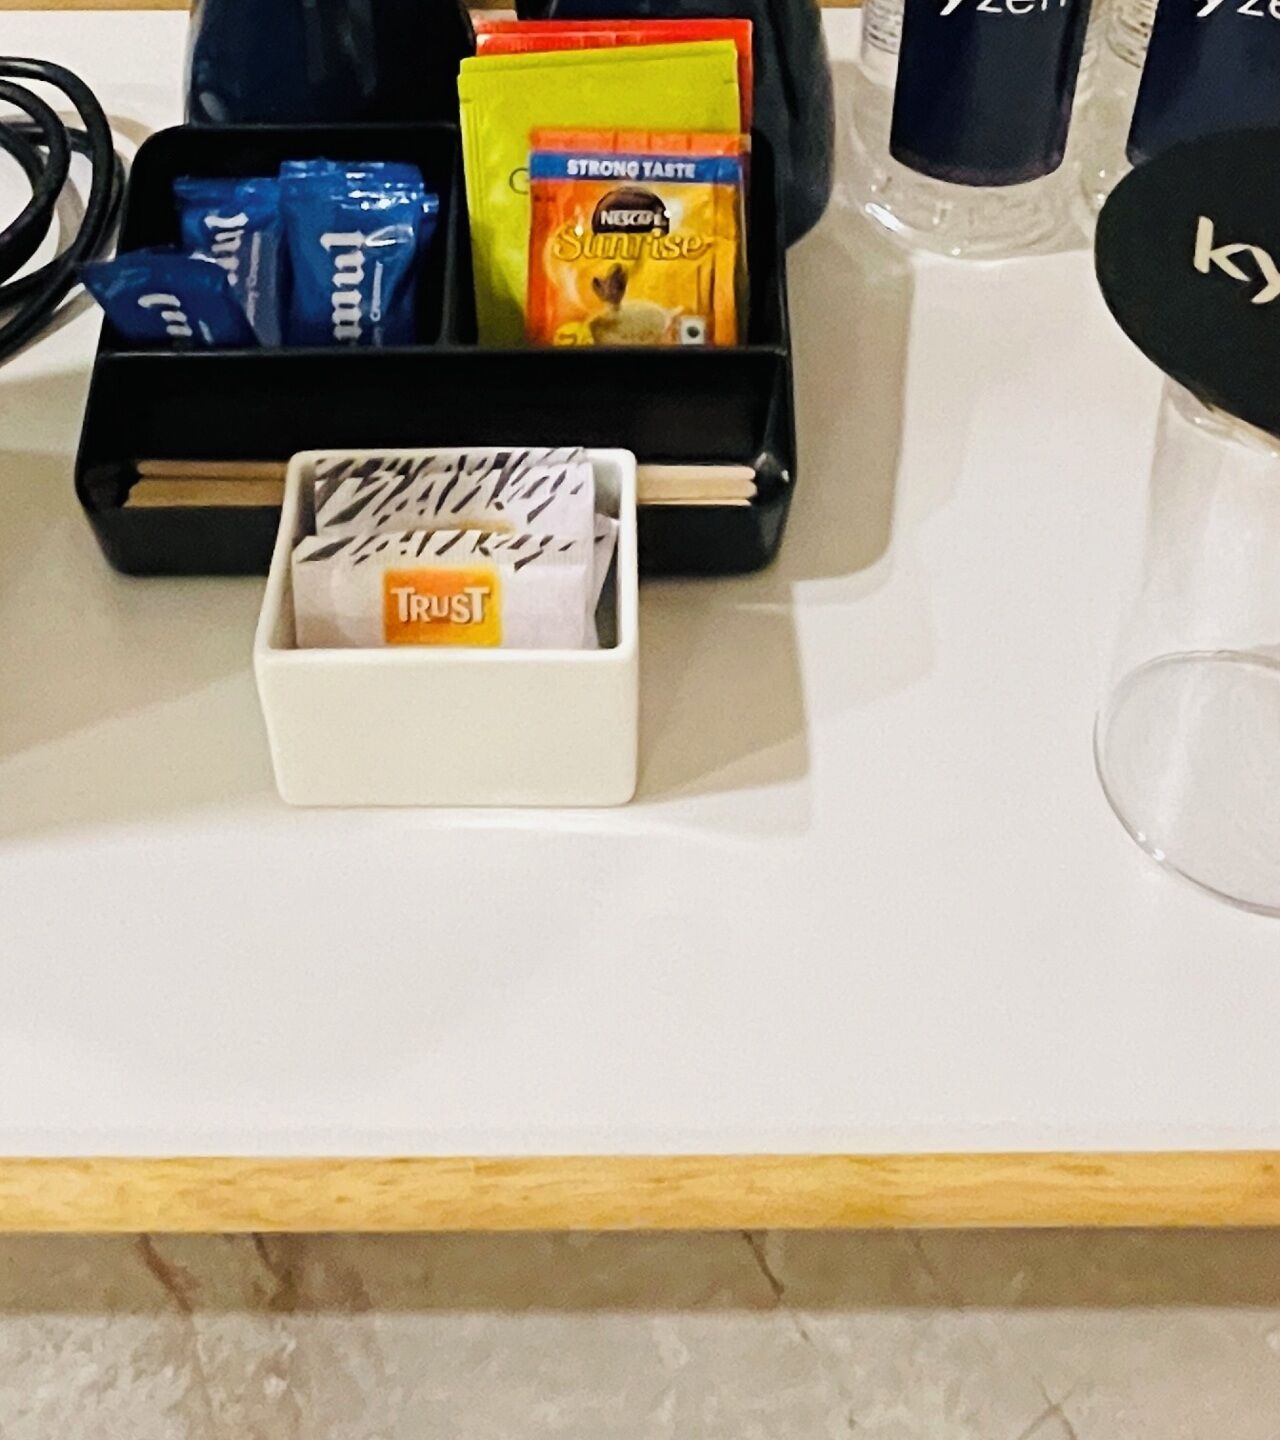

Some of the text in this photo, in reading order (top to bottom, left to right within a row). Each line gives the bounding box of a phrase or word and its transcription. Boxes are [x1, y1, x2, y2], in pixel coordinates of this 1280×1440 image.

[566, 158, 696, 178] STRONG TASTE
[553, 225, 715, 260] Sunrise
[320, 231, 366, 341] mul
[390, 586, 492, 625] TRUST
